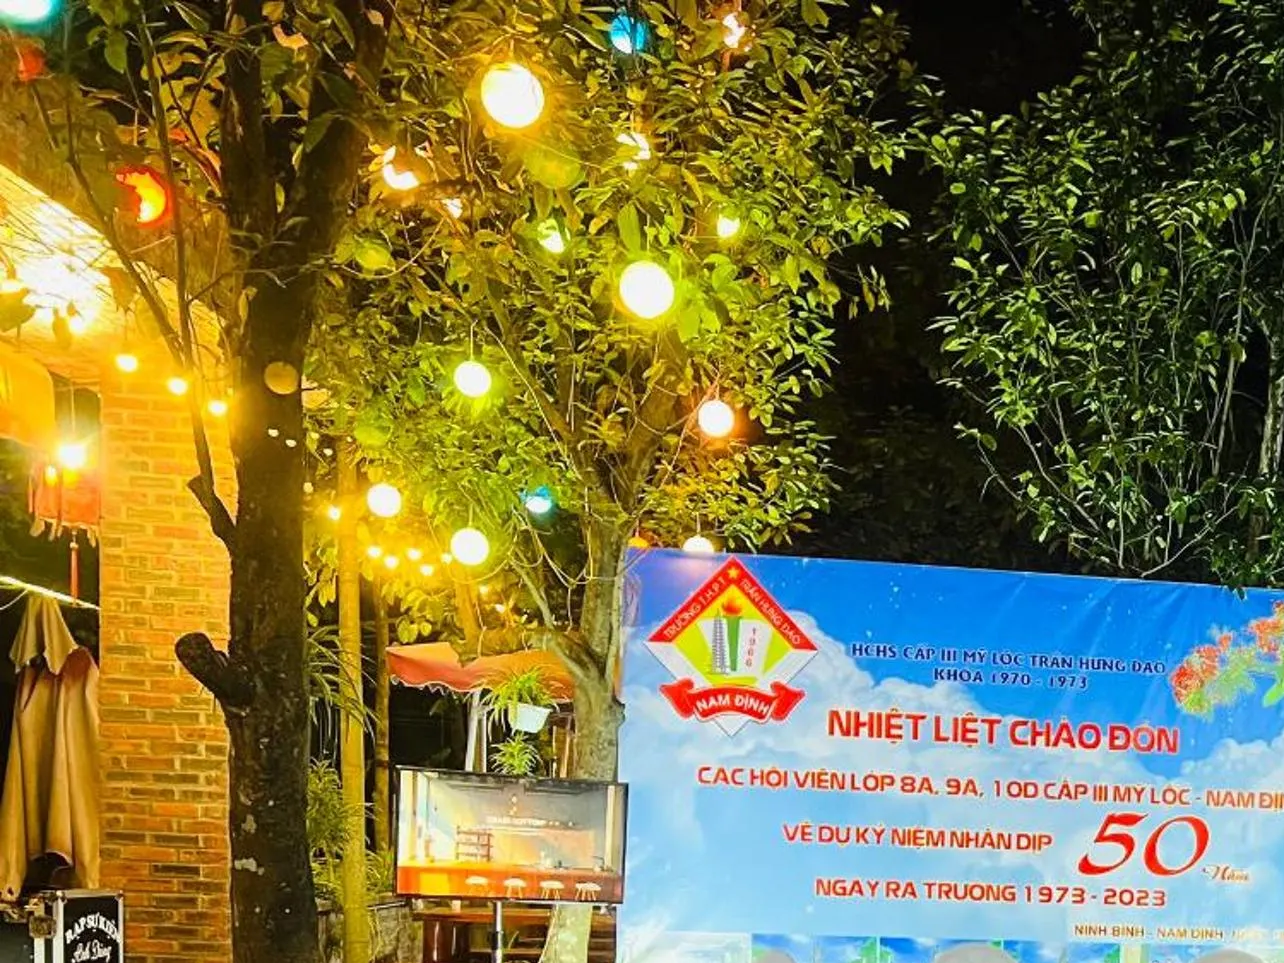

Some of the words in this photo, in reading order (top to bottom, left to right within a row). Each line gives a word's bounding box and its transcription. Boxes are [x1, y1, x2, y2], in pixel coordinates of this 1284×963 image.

[852, 643, 897, 659] HCHS
[941, 648, 957, 662] III
[992, 672, 1031, 686] 1970
[1048, 676, 1088, 689] 1973
[695, 693, 731, 713] NAM
[827, 708, 928, 745] NHIỆT
[934, 712, 1002, 748] LIỆT
[1092, 783, 1109, 803] III
[1205, 790, 1254, 808] NAM
[1078, 812, 1210, 877] 50
[885, 881, 917, 899] RA
[1025, 886, 1086, 904] 1973
[1103, 888, 1167, 907] 2023
[1074, 925, 1107, 936] NINH
